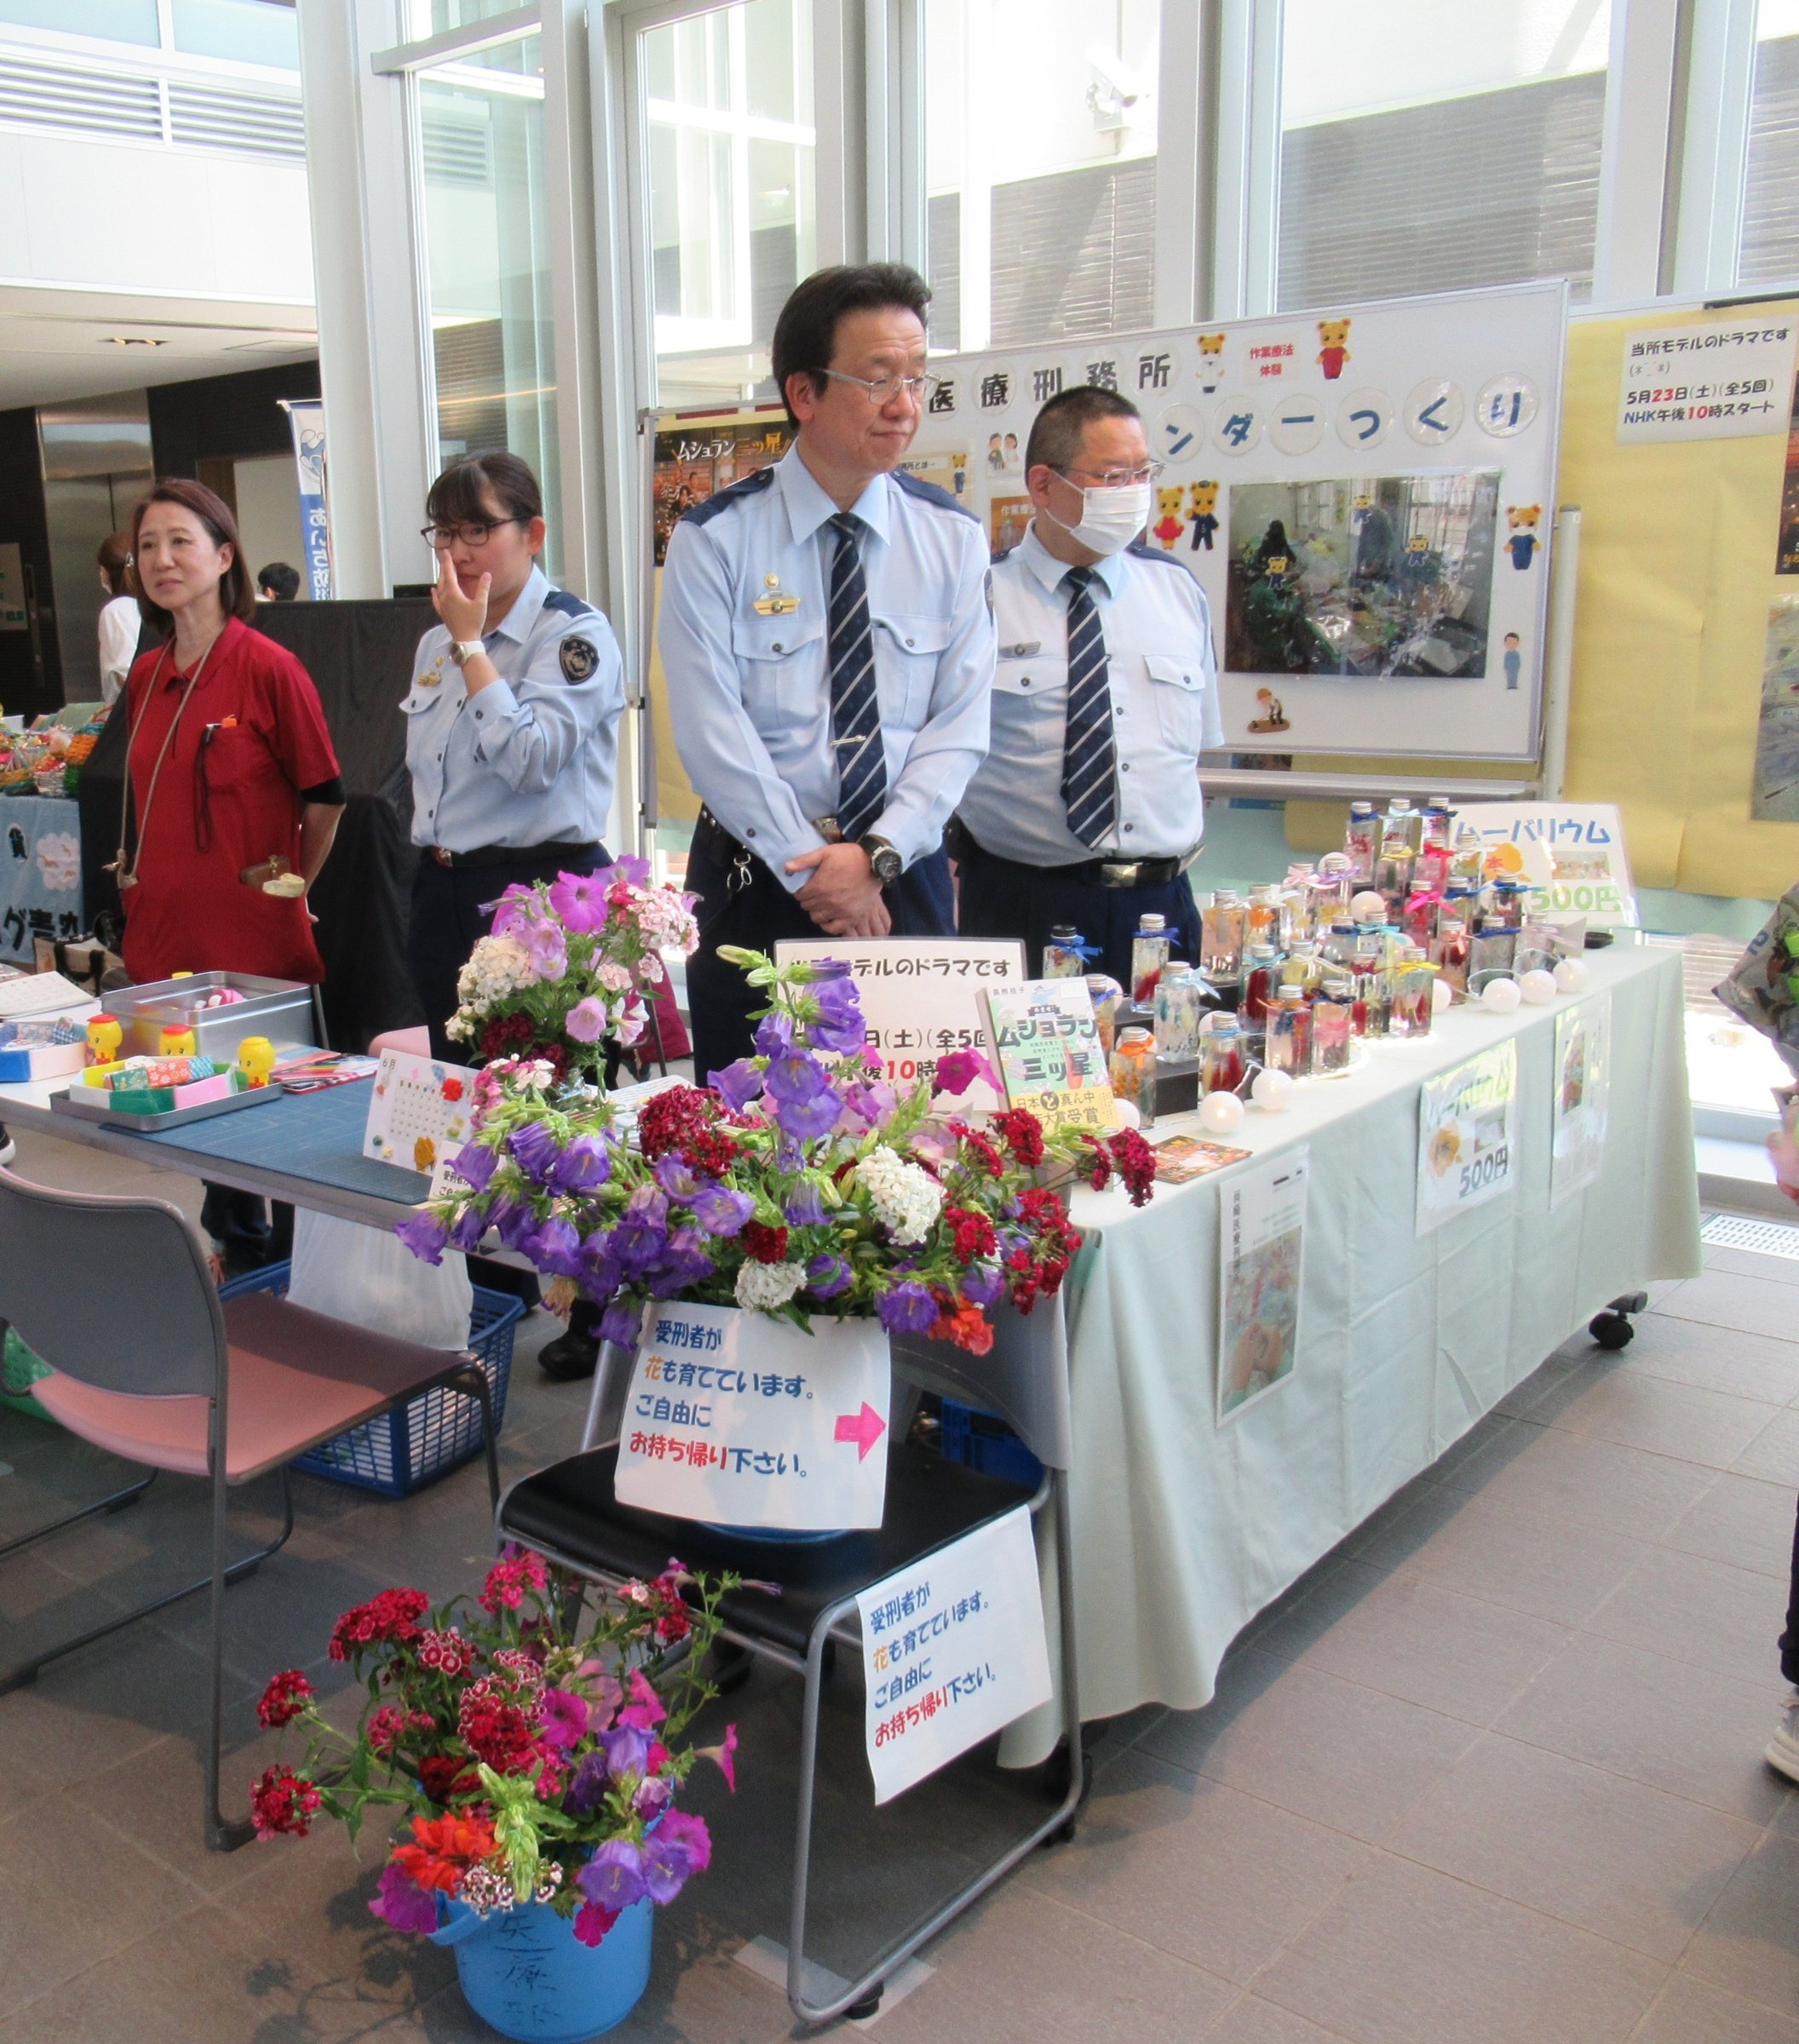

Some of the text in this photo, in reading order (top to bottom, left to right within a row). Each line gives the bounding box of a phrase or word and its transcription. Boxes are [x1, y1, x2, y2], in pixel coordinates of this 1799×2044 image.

[1630, 328, 1790, 357] 当所モデルのドラマです
[928, 353, 1172, 414] 医療刑務所
[1626, 379, 1774, 405] 5月23日(土)(全5回)
[1624, 400, 1775, 424] NHK午後10時スタート
[791, 957, 1011, 979] デルのドラマです
[796, 1028, 986, 1048] 日(土)(全5回
[1022, 1052, 1093, 1082] 三ツ星
[1459, 1145, 1508, 1197] 500円
[655, 1320, 722, 1351] 受刑者が
[644, 1355, 813, 1399] 花も育てています。
[635, 1394, 711, 1427] ご自由に
[629, 1431, 808, 1477] お持ち帰り下さい。
[871, 1582, 930, 1635] 受刑者が
[872, 1590, 989, 1674] 花も育てています。
[874, 1657, 933, 1709] ご自由に
[875, 1662, 996, 1748] お持ち帰り下さい。
